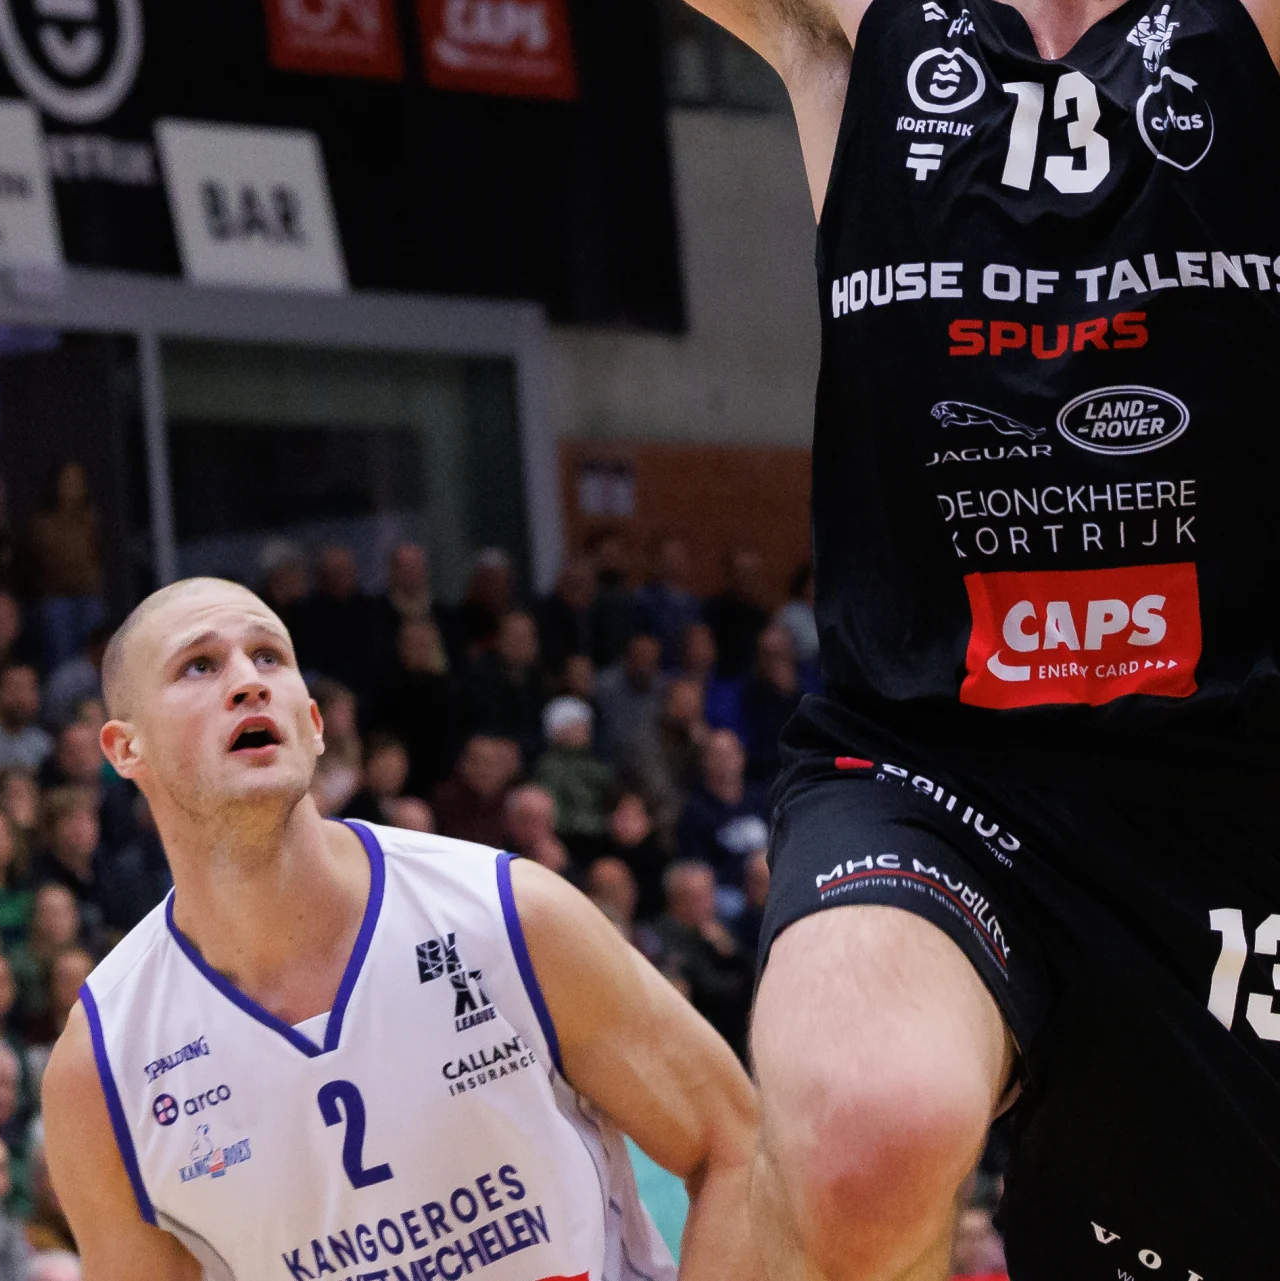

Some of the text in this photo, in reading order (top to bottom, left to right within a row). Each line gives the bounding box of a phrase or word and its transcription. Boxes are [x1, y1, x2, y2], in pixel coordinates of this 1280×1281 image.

[1001, 70, 1110, 195] 13
[200, 178, 308, 248] BAR
[831, 261, 963, 318] HOUSE
[982, 263, 1060, 304] OF
[949, 311, 1150, 360] SPURS
[924, 443, 1053, 466] JAGUAR
[937, 479, 1197, 521] DEJONCKHEERE
[1002, 594, 1168, 653] CAPS
[1095, 660, 1139, 678] CARD
[816, 854, 901, 888] MHC
[448, 1051, 537, 1097] INSURANCE
[183, 1084, 231, 1116] arco
[317, 1079, 394, 1189] 2
[281, 1164, 527, 1281] KANGOEROES
